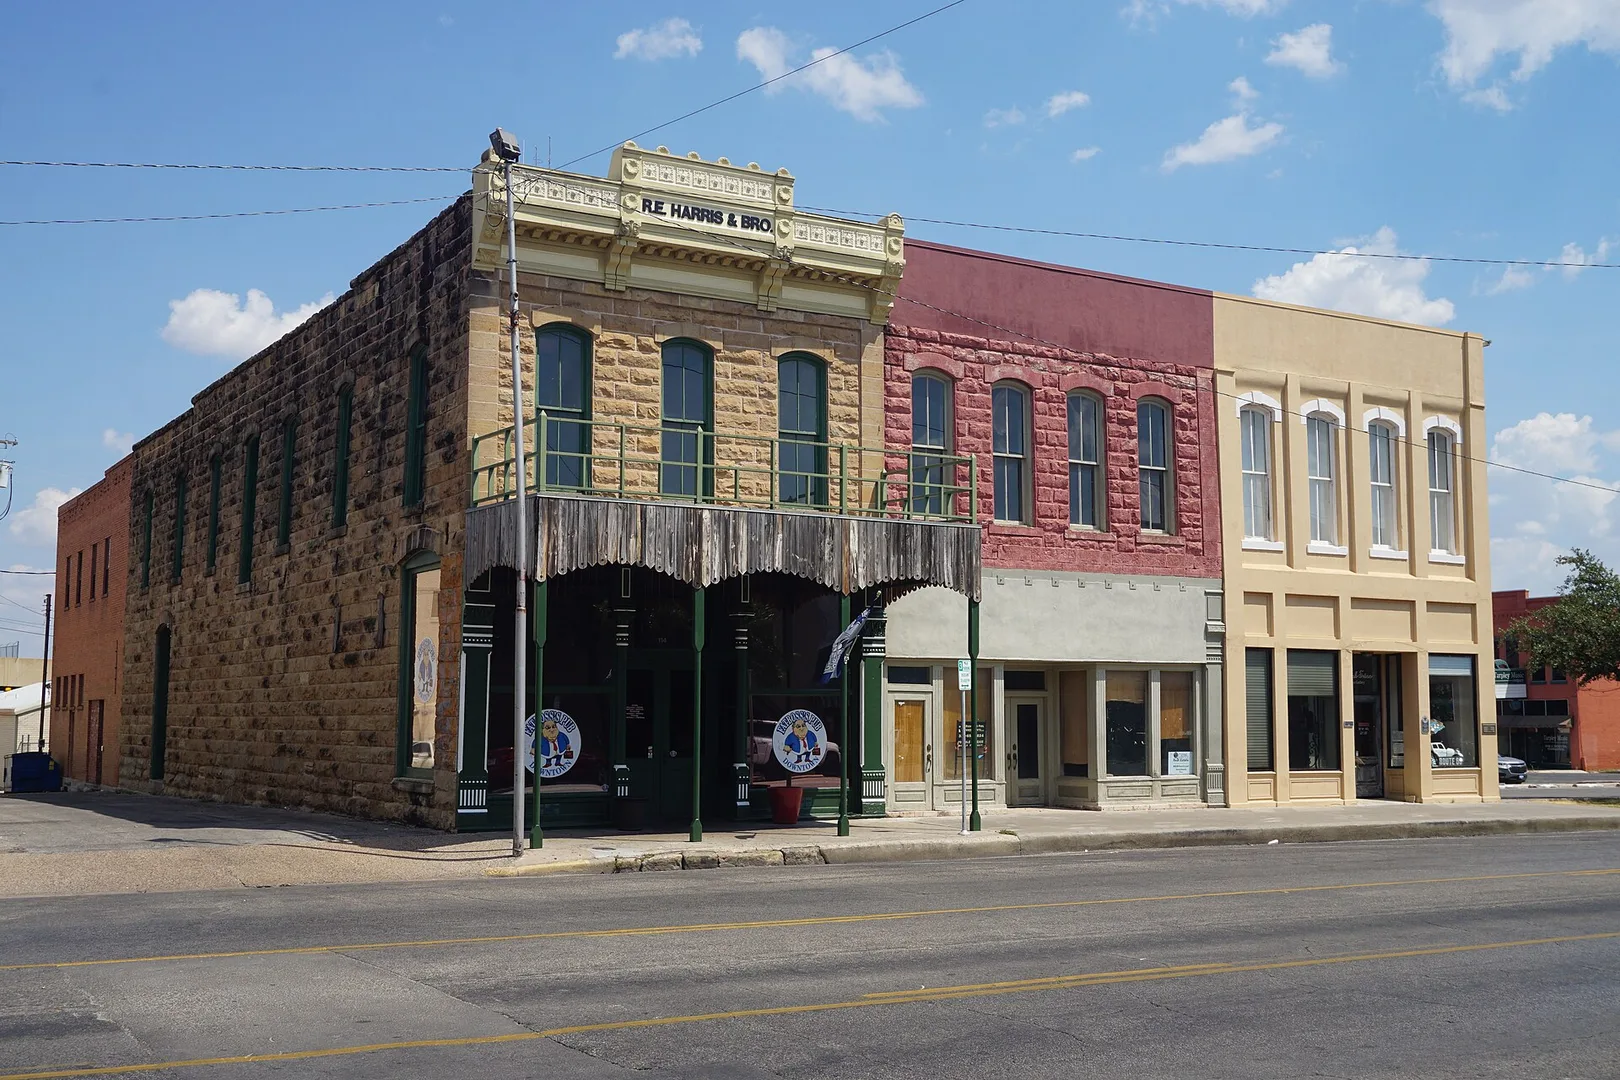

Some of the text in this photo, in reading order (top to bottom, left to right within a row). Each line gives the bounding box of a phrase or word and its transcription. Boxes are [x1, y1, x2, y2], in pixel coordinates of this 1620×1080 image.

[642, 198, 774, 233] R.E. HARRIS & BRO.
[561, 714, 576, 733] PUB
[808, 713, 823, 732] PUB
[783, 757, 819, 771] DOWNTOWN
[1439, 757, 1455, 766] ROUTE
